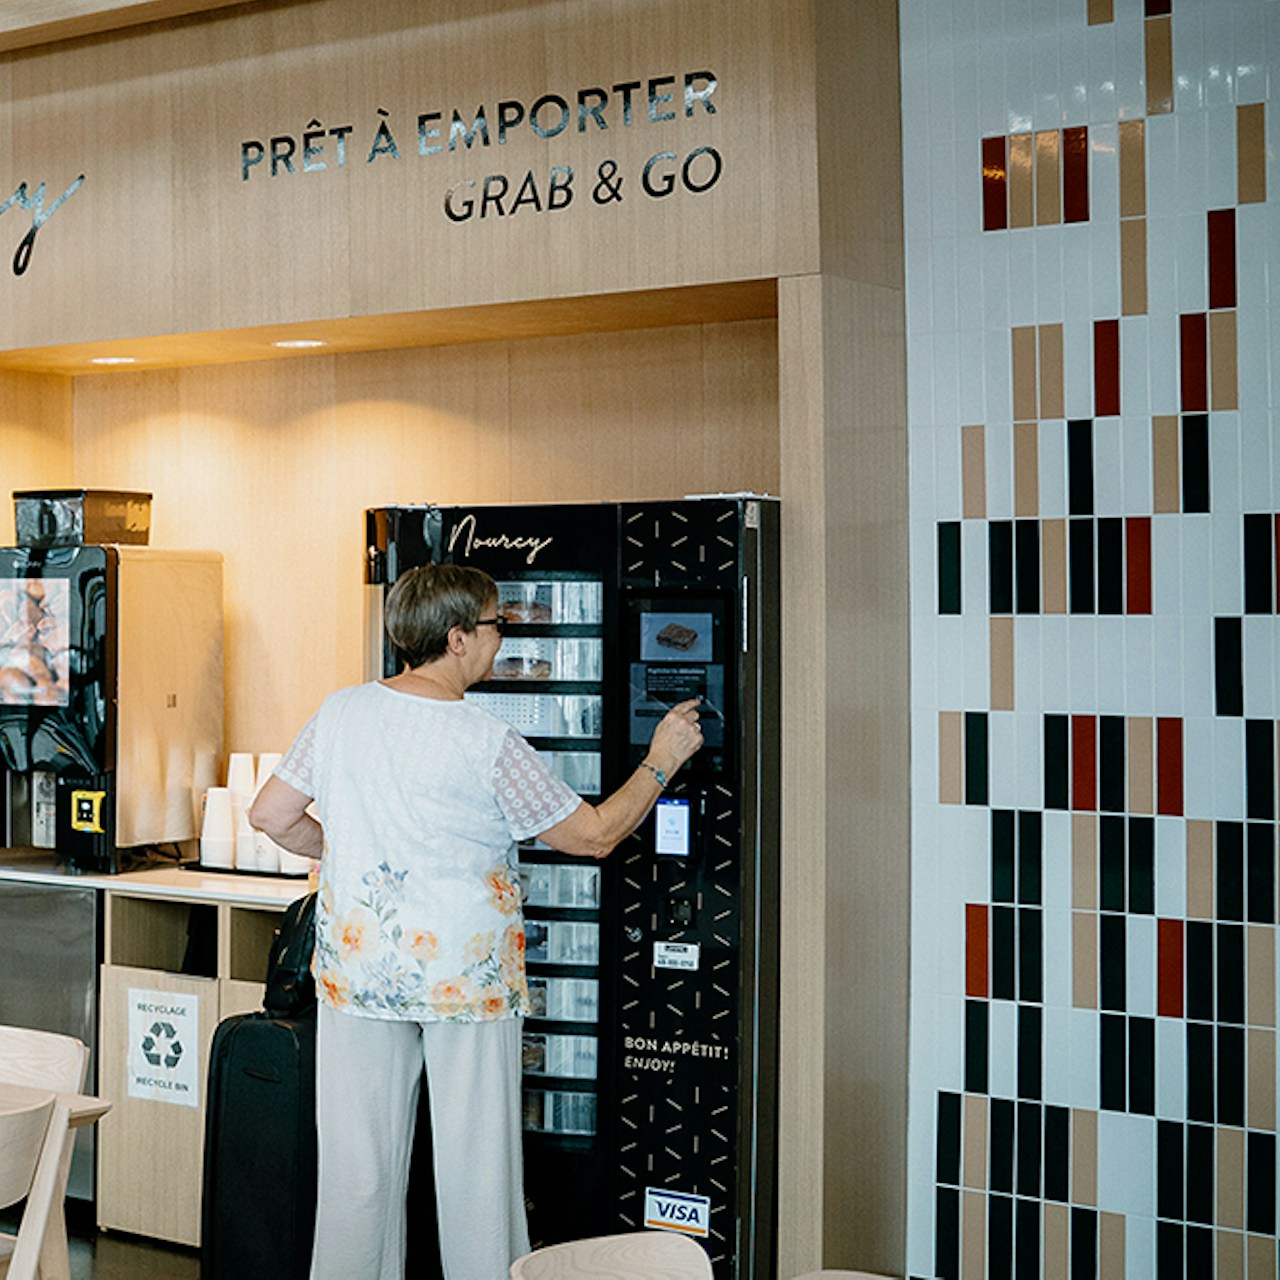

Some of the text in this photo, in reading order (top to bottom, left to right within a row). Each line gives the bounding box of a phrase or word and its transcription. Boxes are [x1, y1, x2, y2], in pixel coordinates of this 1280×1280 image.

[241, 70, 719, 182] PRÊT À EMPORTER
[444, 145, 723, 223] GRAB & GO
[447, 513, 554, 565] Nourcy
[137, 1003, 186, 1016] RECYCLAGE
[624, 1036, 658, 1051] BON
[624, 1055, 676, 1073] ENJOY!
[136, 1077, 188, 1091] RECYCLE BIN
[655, 1200, 700, 1224] VISA
